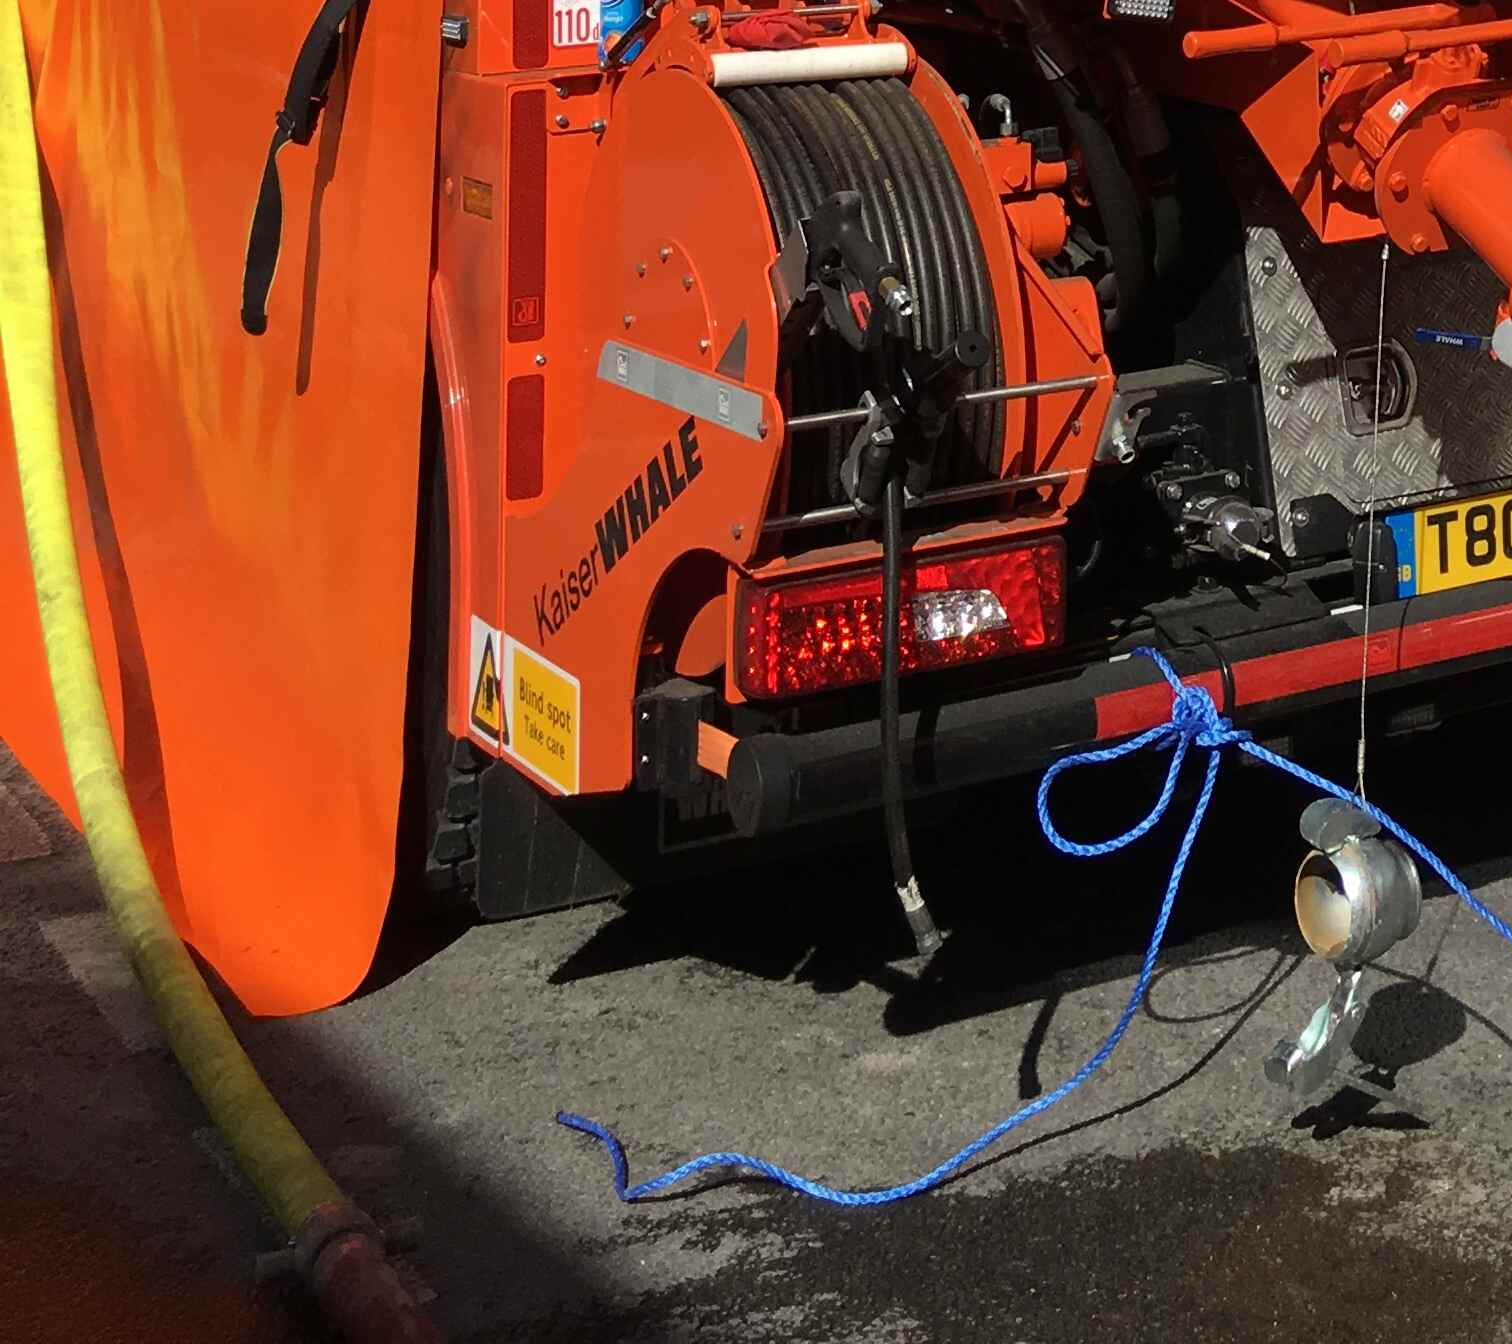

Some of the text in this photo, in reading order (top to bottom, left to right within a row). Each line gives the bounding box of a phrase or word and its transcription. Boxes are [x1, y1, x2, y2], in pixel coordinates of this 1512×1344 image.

[533, 414, 704, 647] KaiserWHALE
[519, 676, 572, 734] Blind spot
[524, 715, 566, 761] Take care
